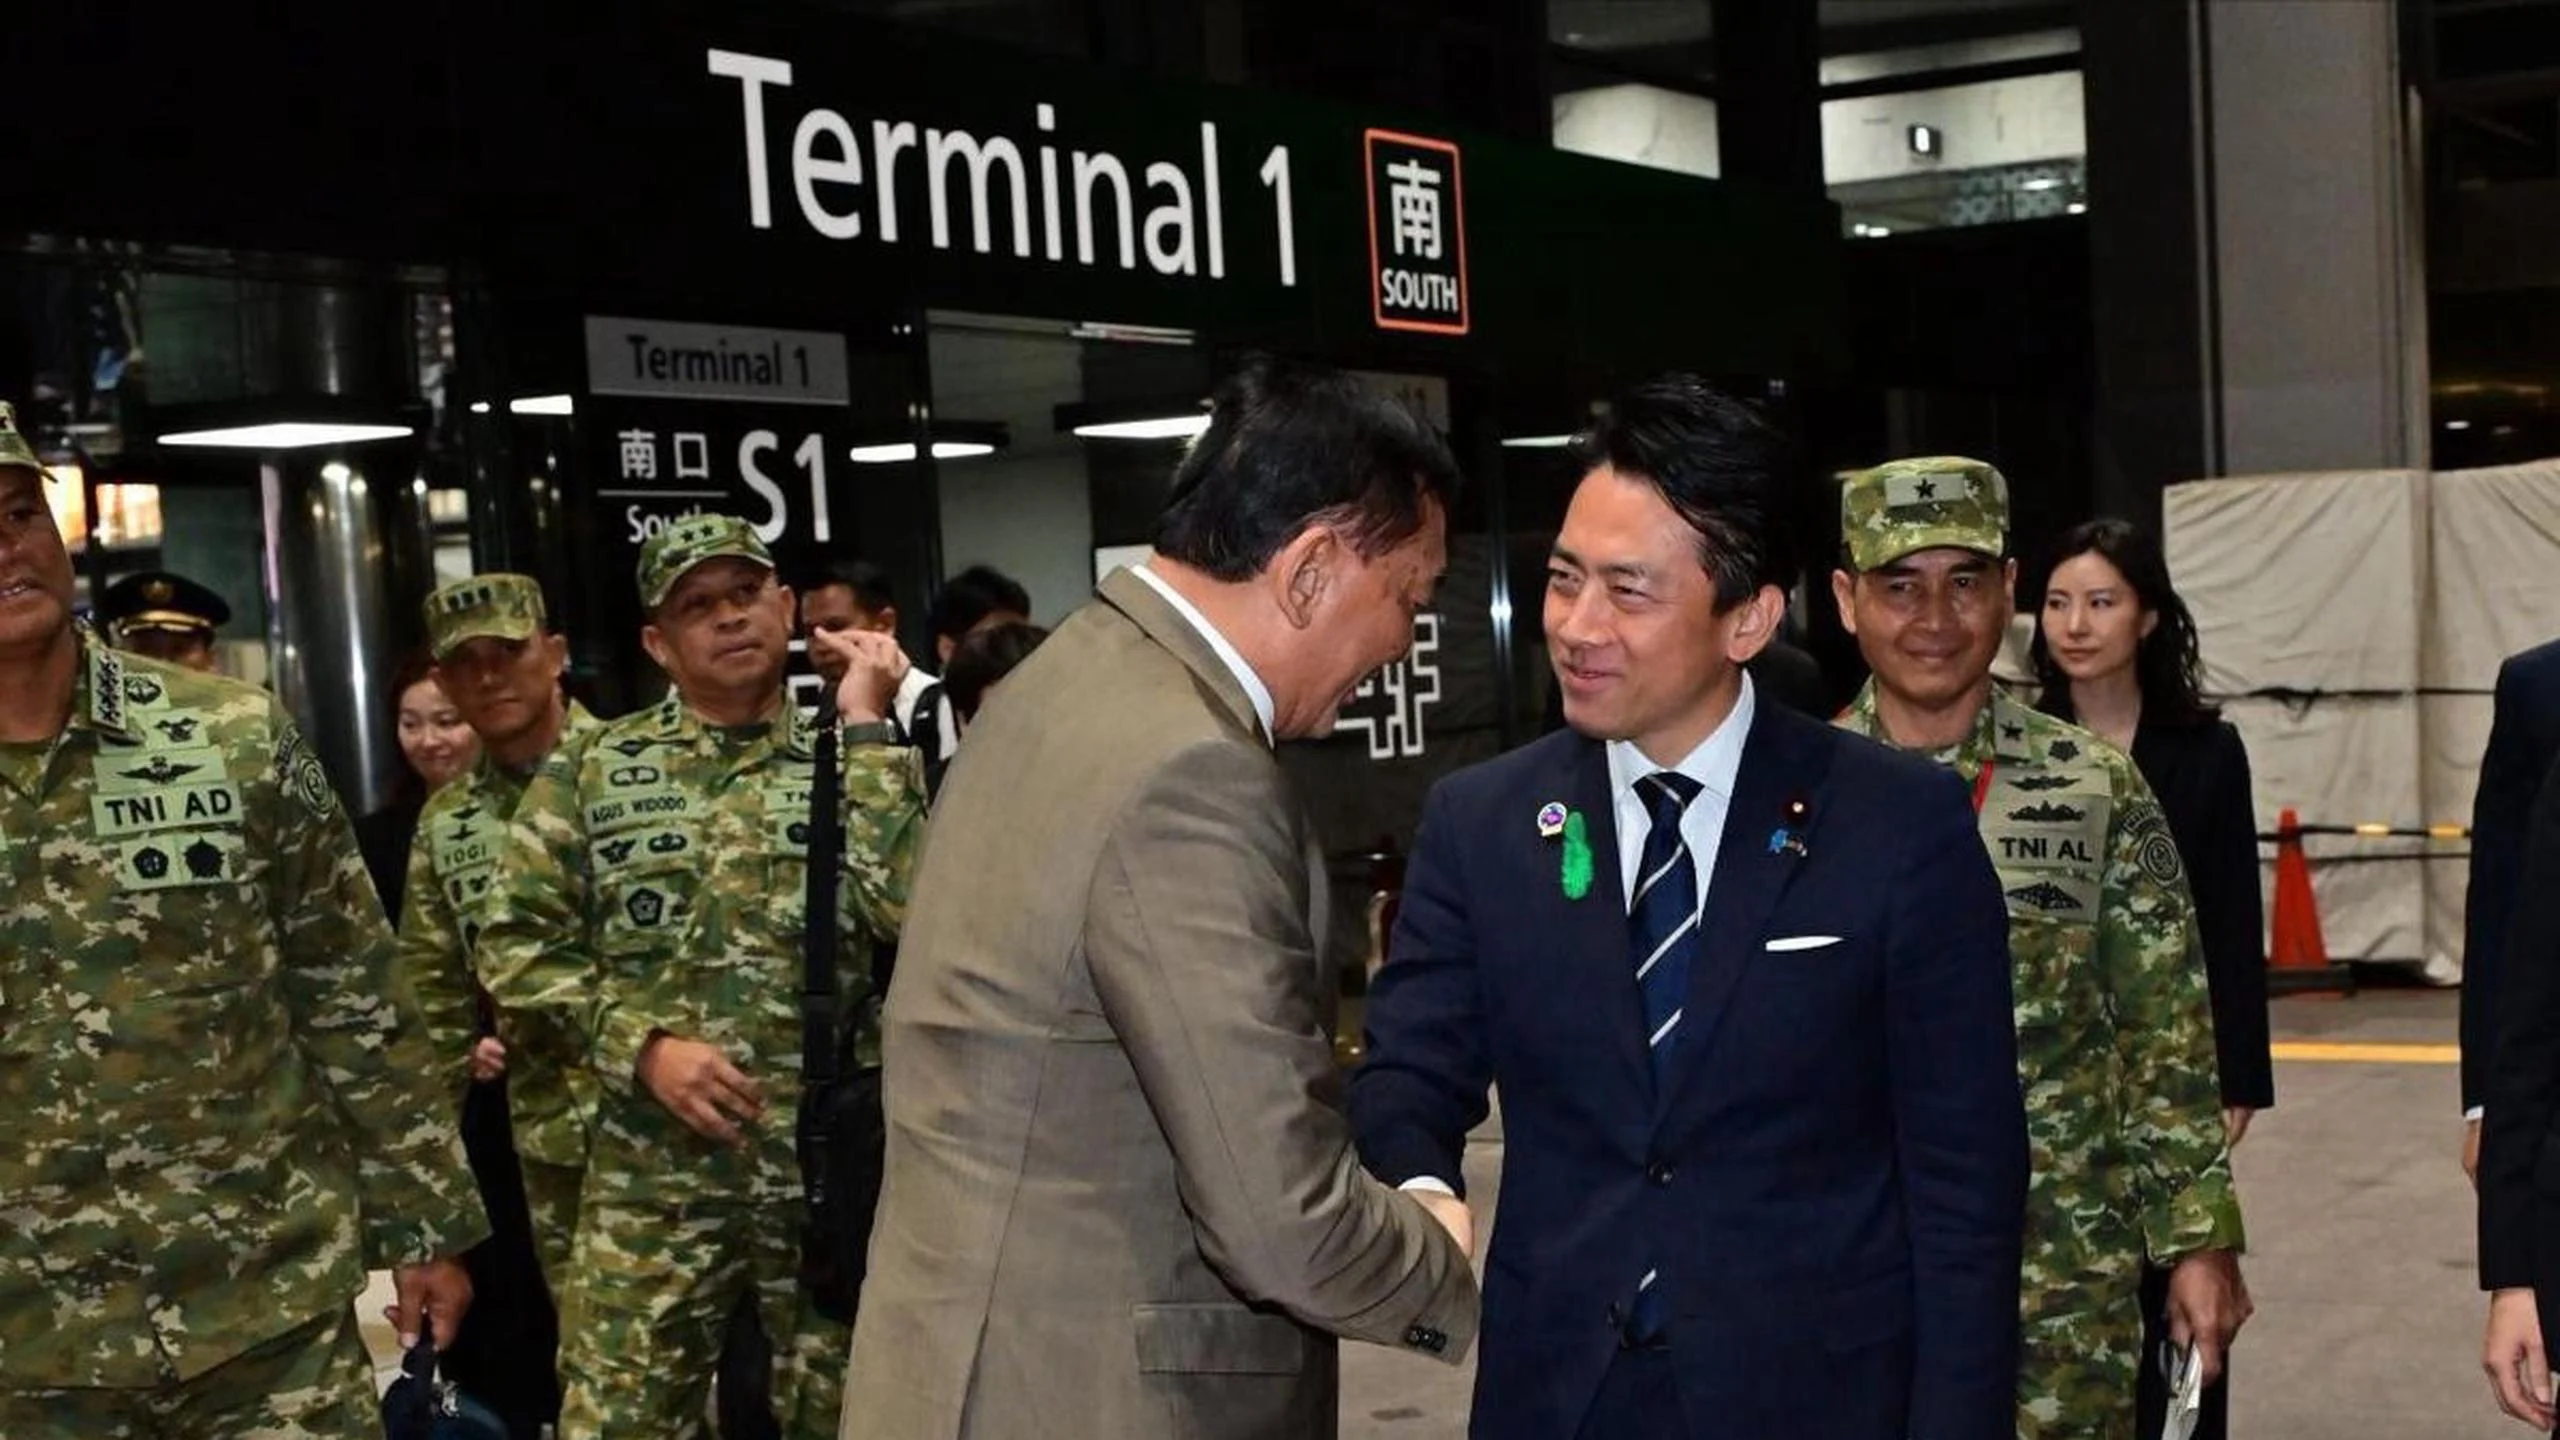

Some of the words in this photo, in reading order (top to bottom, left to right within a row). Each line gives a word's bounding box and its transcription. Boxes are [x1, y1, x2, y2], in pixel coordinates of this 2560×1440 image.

[707, 48, 1224, 279] Terminal
[1259, 144, 1296, 287] 1
[1386, 158, 1442, 260] 南
[1381, 267, 1460, 314] SOUTH
[626, 333, 783, 386] Terminal
[793, 346, 810, 388] 1
[617, 427, 710, 480] 南口
[738, 429, 831, 543] S1
[104, 795, 166, 826] TNI
[184, 788, 232, 820] AD
[1998, 836, 2047, 860] TNI
[2056, 838, 2094, 864] AL
